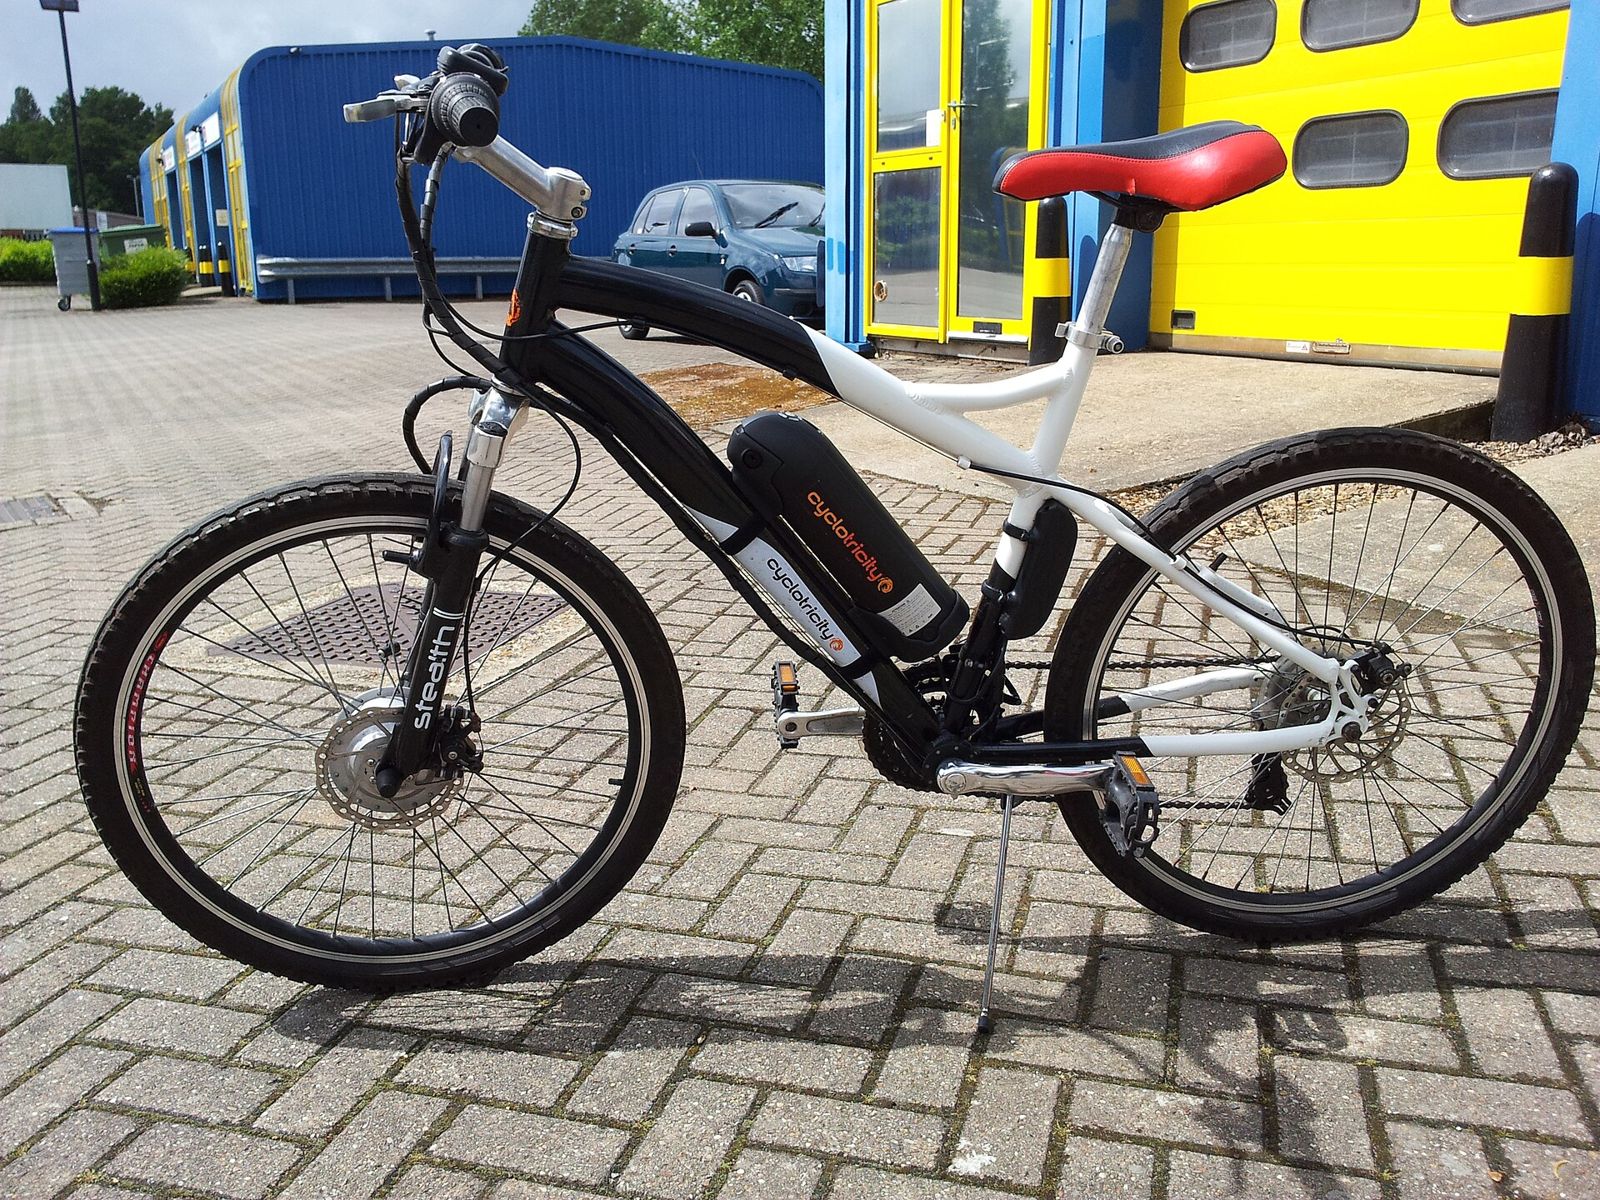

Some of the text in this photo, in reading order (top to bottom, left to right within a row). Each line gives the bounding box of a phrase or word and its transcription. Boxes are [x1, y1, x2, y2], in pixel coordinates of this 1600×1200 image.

[807, 491, 882, 582] cyclotricity
[767, 558, 833, 640] cyclotricity
[414, 625, 455, 729] stealth
